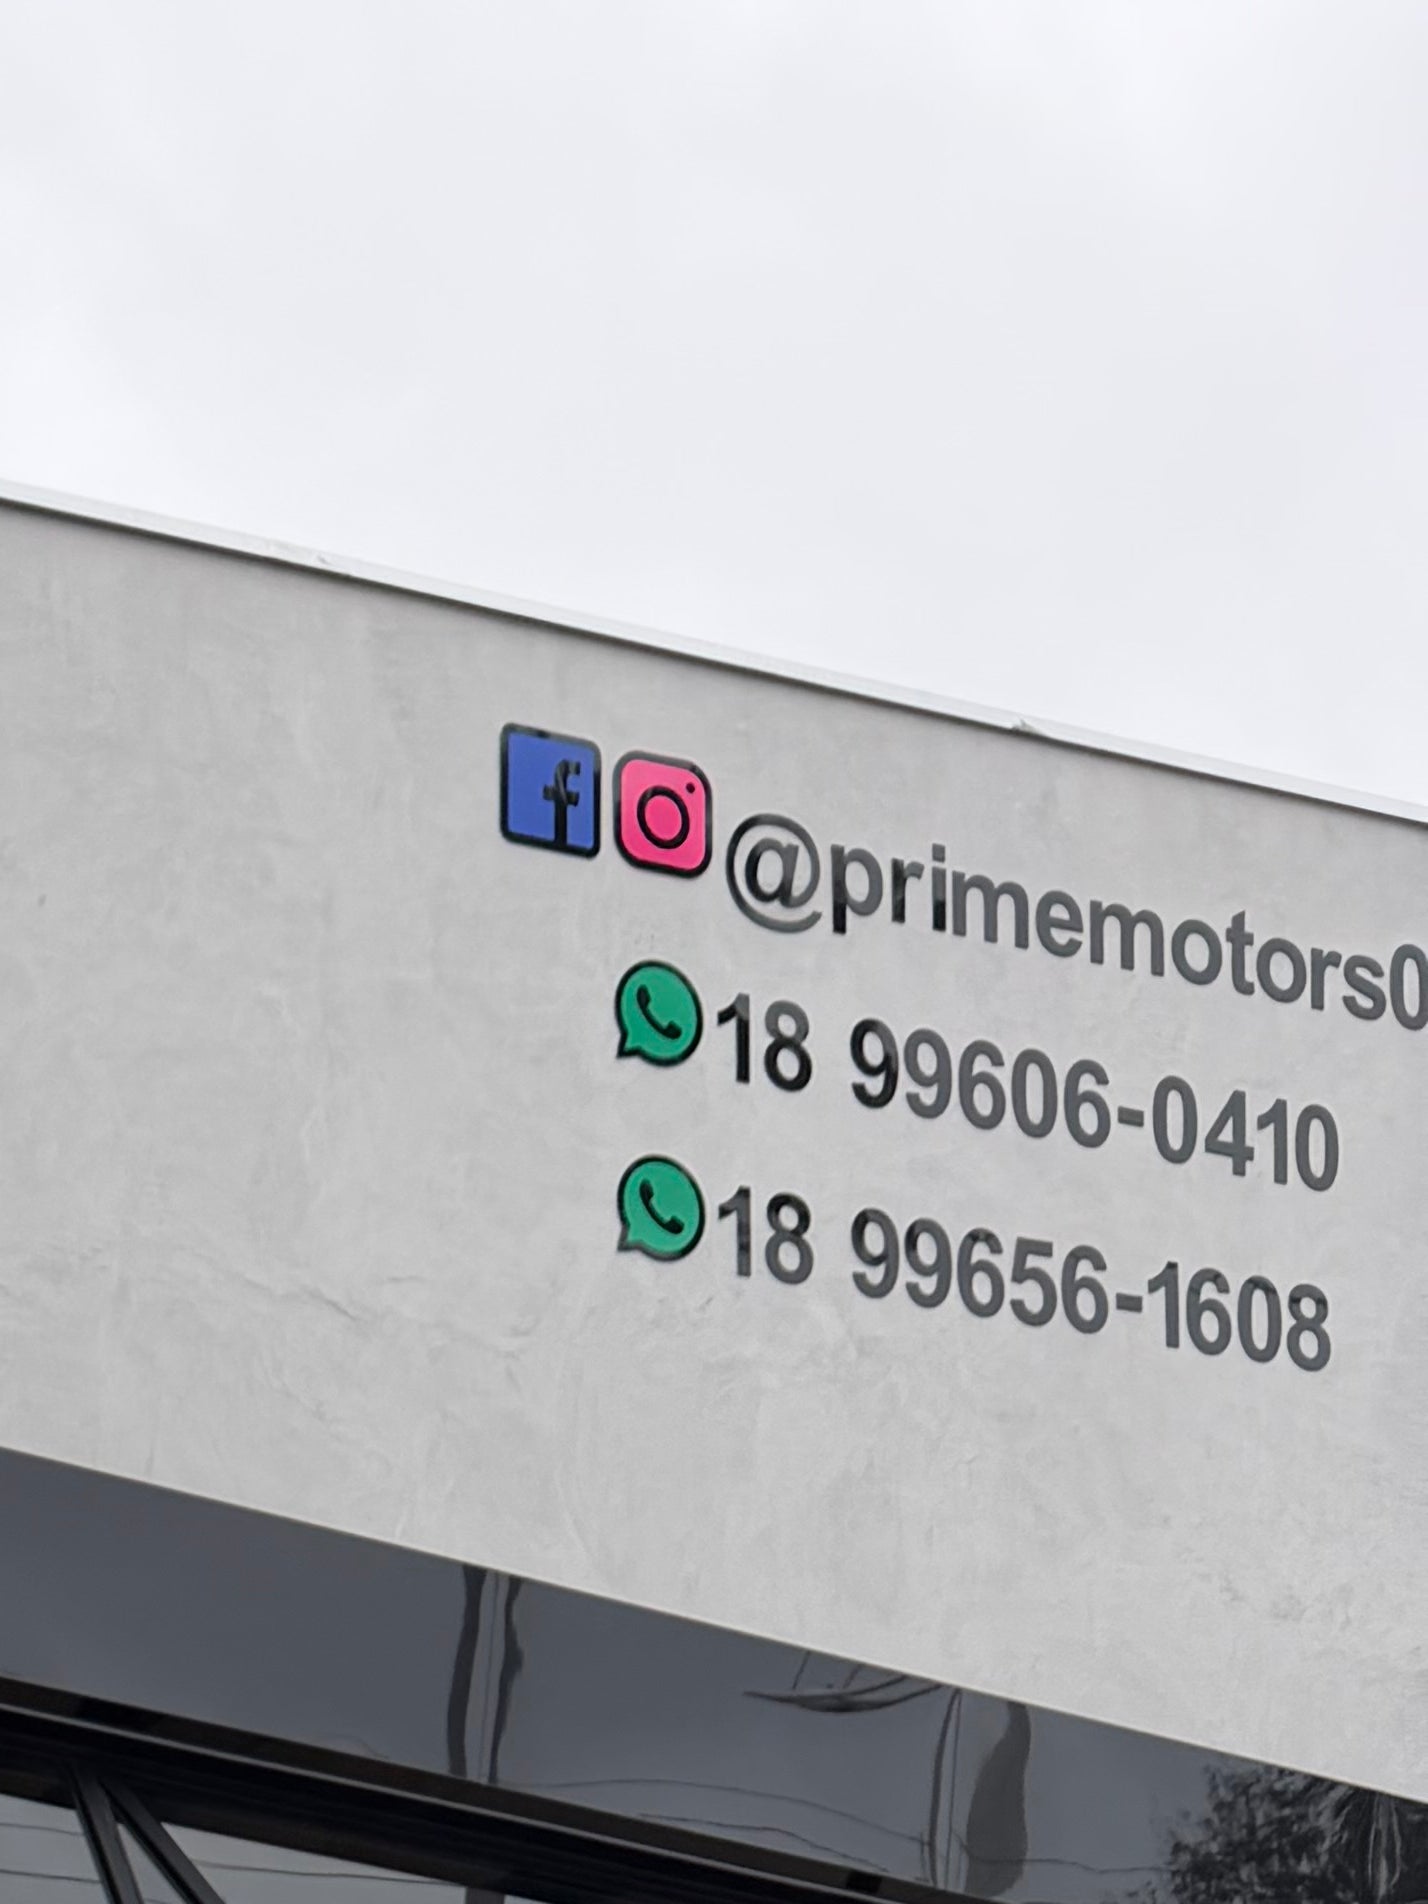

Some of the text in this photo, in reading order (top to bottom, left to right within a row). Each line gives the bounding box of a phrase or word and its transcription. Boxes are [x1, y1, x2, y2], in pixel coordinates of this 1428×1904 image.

[725, 812, 1428, 1031] @primemotors0
[716, 993, 1339, 1192] 18 99606-0410
[717, 1185, 1331, 1372] 18 99656-1608
